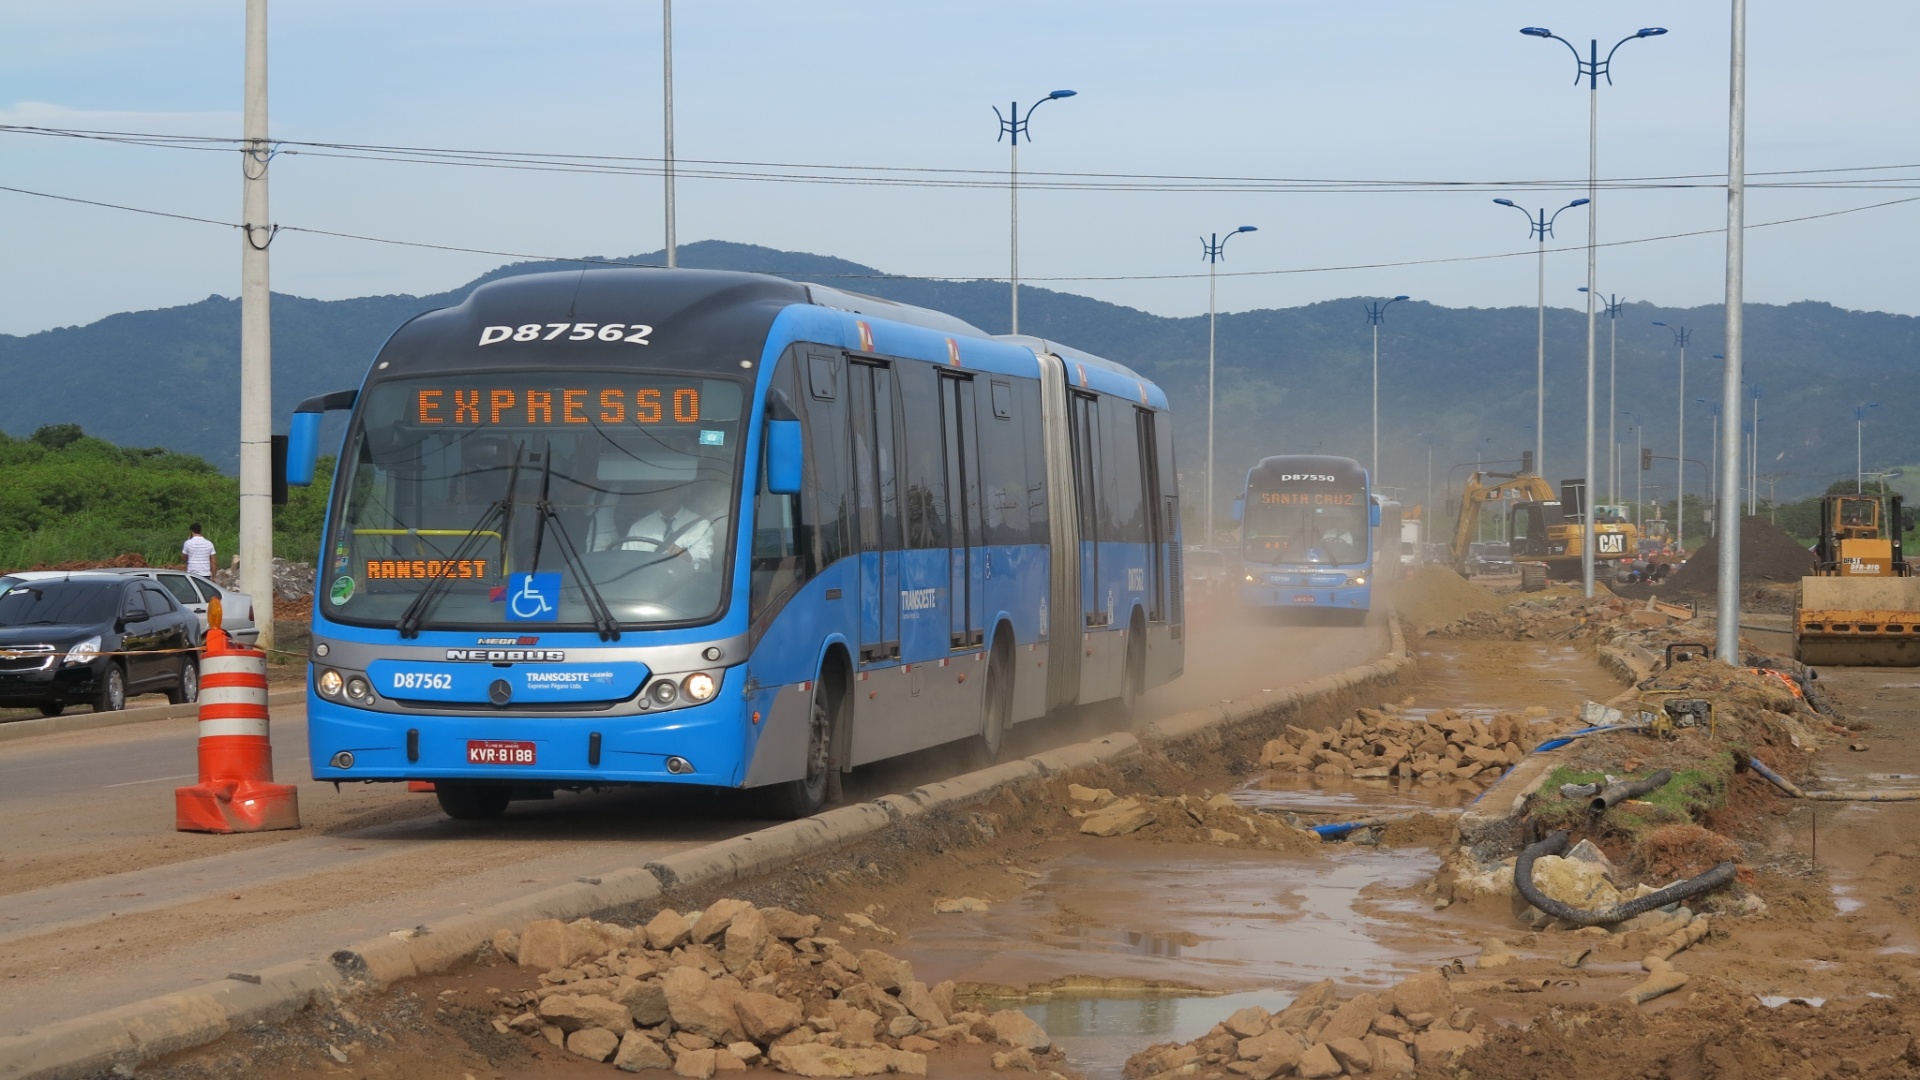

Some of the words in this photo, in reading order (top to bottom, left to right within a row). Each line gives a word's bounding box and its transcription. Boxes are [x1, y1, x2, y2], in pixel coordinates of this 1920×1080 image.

[478, 323, 653, 347] D87562
[418, 389, 699, 423] EXPRESSO
[1281, 474, 1335, 482] D87550
[1262, 493, 1309, 505] SANTA
[1315, 494, 1353, 506] CRUZ
[1599, 535, 1624, 553] CAT
[446, 649, 564, 662] NEOBUS
[394, 672, 452, 689] D87562
[526, 672, 589, 682] TRANSOESTE
[470, 748, 533, 762] KVR-8188
